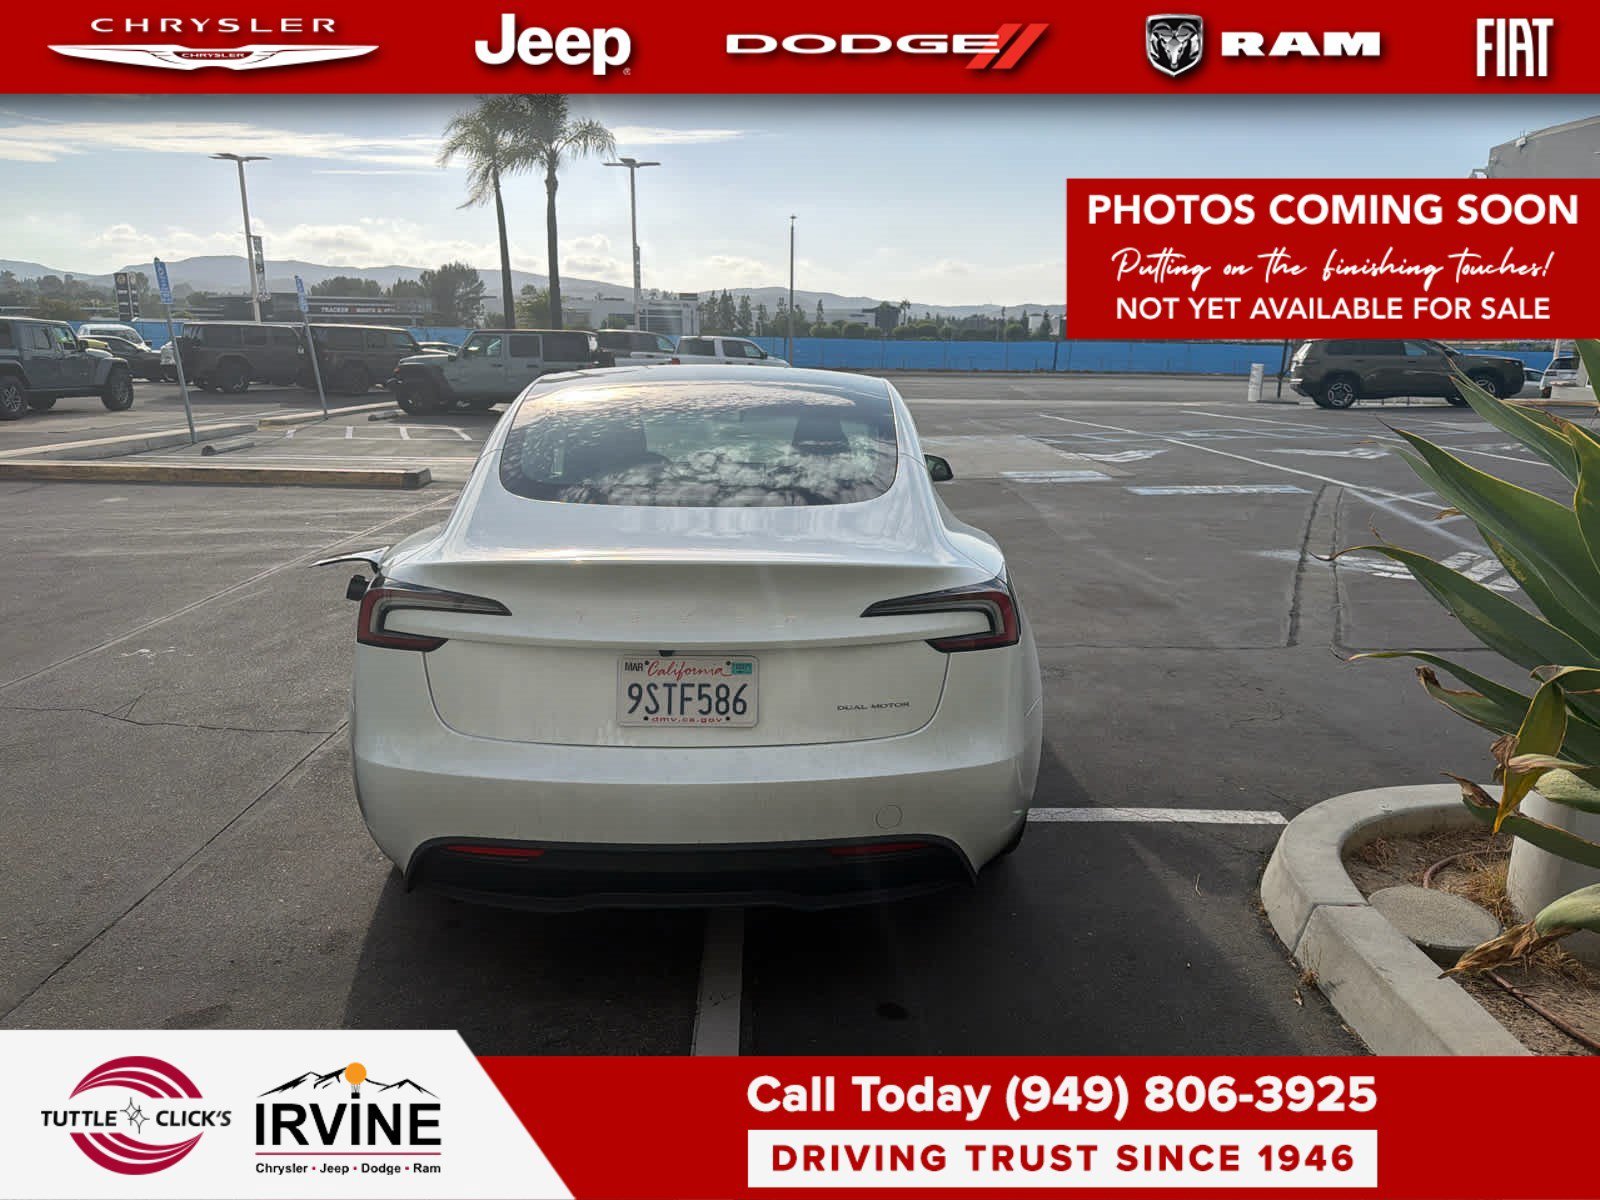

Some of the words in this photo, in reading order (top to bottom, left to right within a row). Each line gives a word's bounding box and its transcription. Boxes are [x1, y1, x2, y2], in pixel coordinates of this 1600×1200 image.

[624, 662, 644, 672] MAR
[647, 660, 732, 681] California
[627, 682, 749, 716] 9STF586
[871, 701, 909, 709] MOTOR
